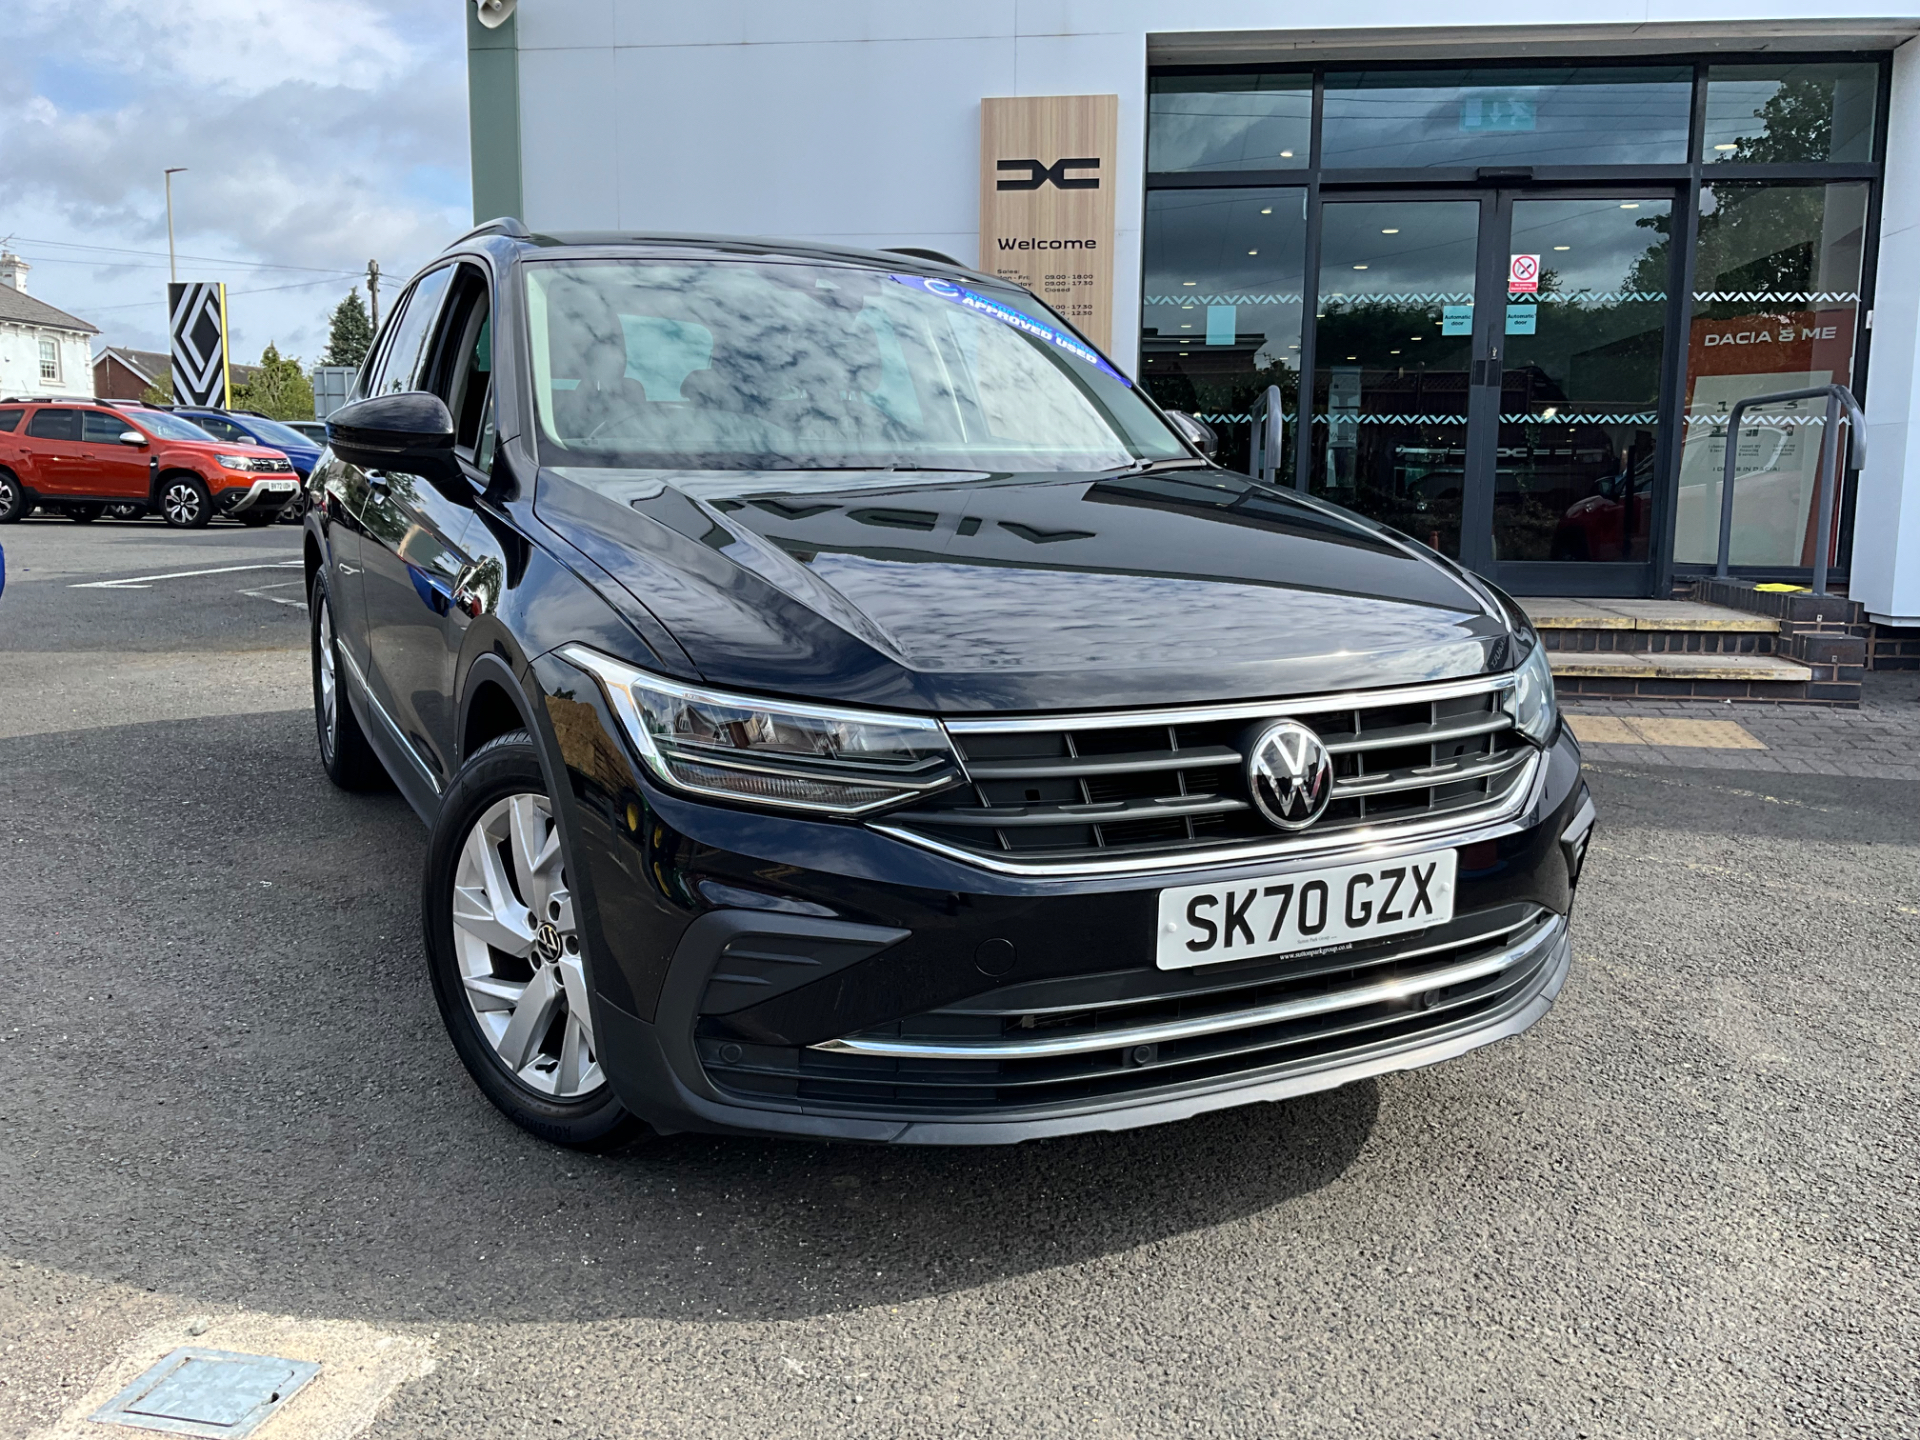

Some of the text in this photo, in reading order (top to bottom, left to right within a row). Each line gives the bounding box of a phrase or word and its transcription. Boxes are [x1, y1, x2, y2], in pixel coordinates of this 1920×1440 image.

[998, 237, 1097, 251] Welcome
[962, 297, 1098, 364] APPROVED USED
[1704, 326, 1837, 346] DACIA & ME
[1717, 401, 1729, 412] 1
[1185, 862, 1437, 952] SK70 GZX
